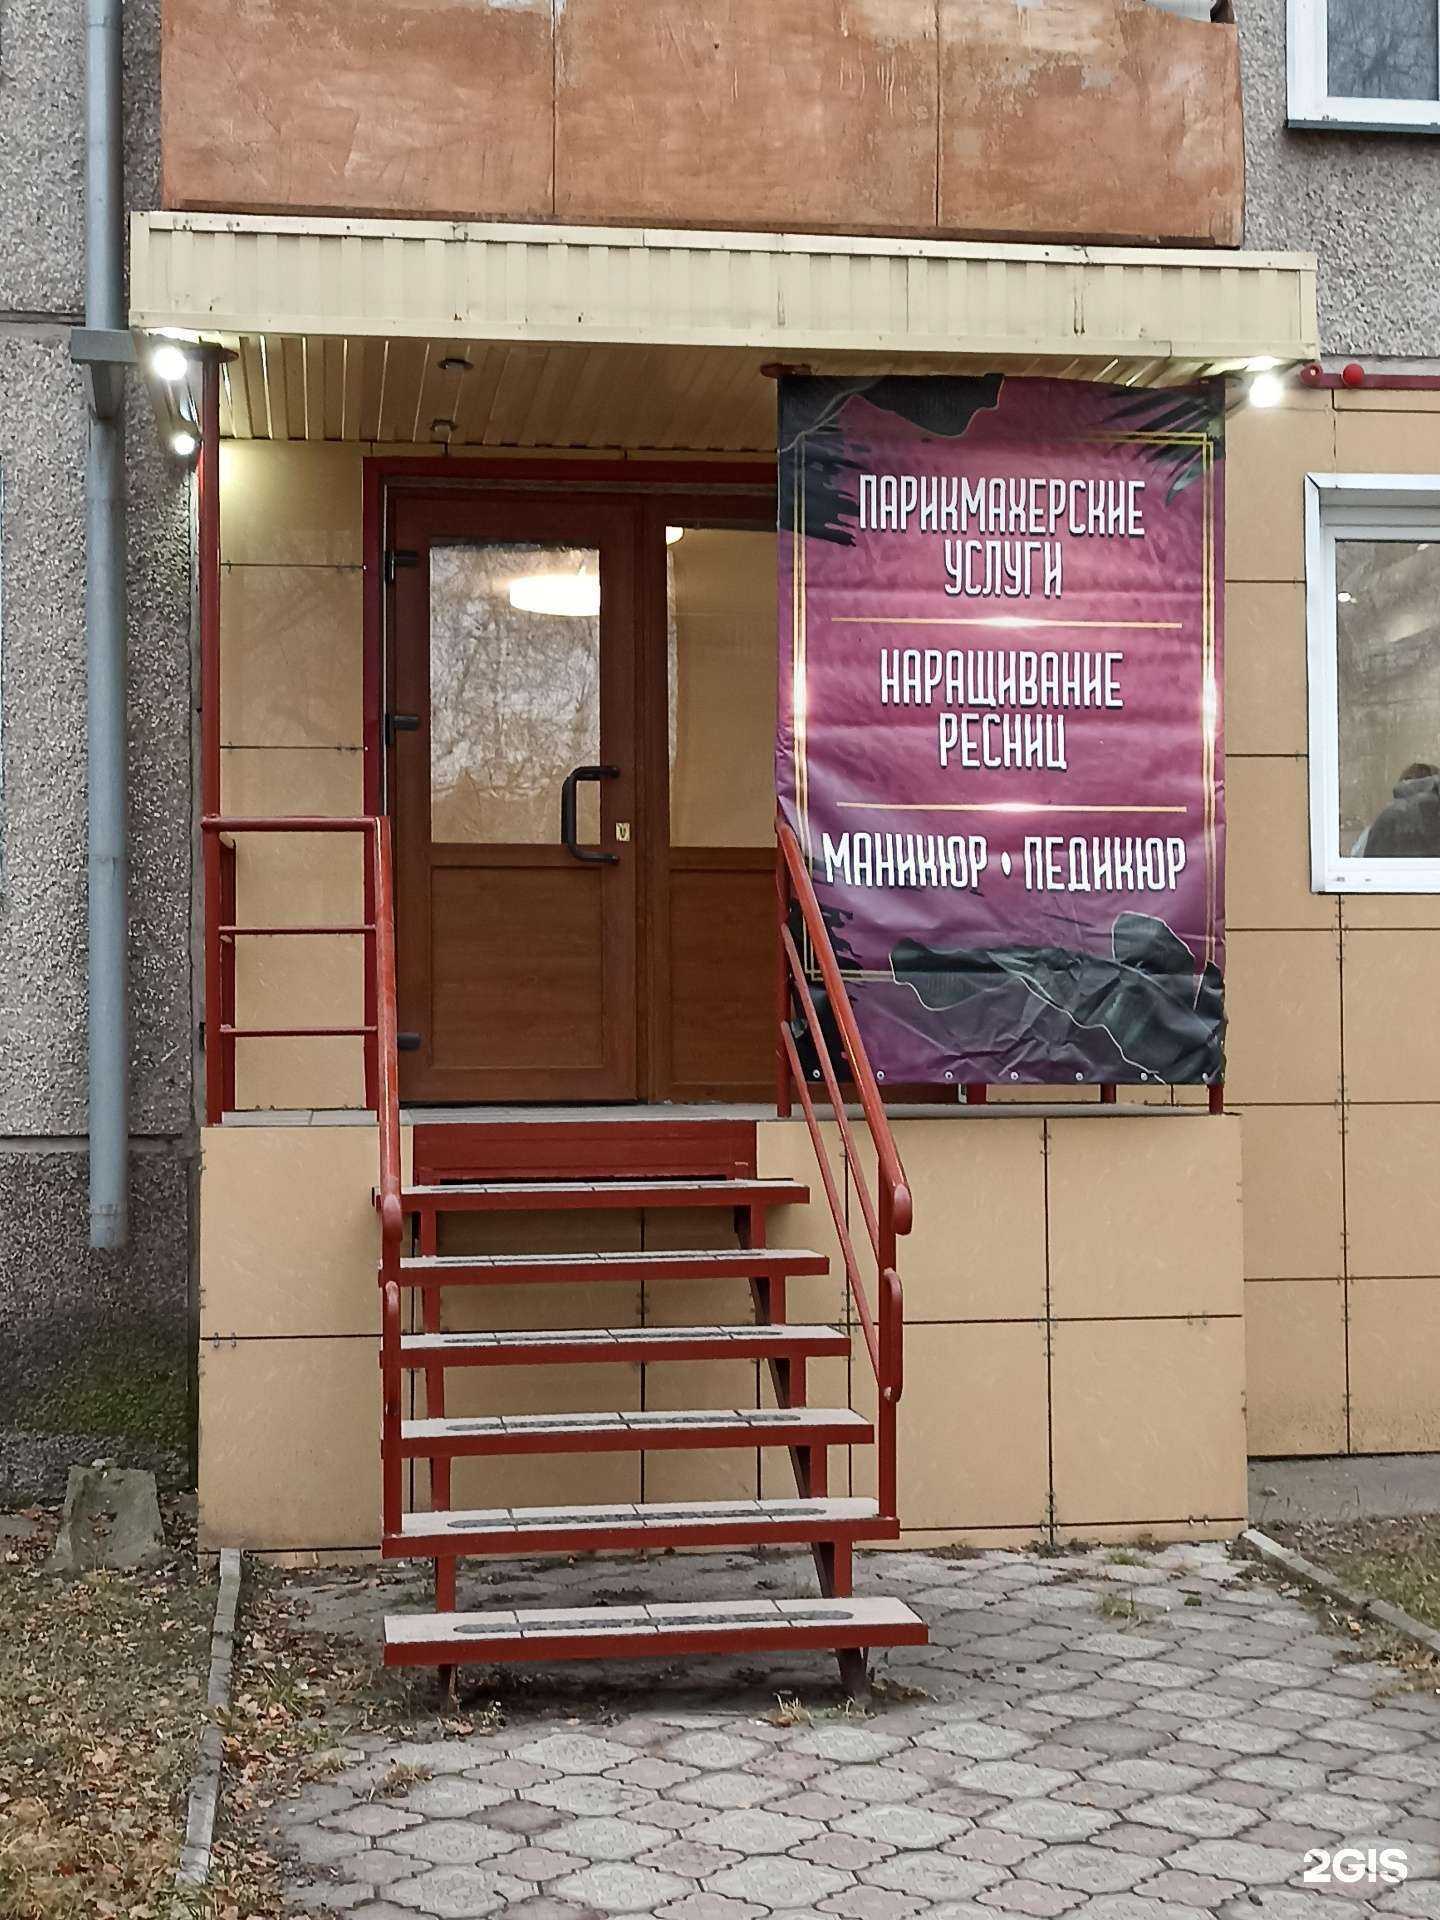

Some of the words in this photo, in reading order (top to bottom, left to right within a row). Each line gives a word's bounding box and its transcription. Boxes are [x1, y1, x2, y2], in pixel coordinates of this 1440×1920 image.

[859, 474, 1146, 536] ПАРИКМАХЕРСКИЕ
[944, 540, 1063, 597] УСЛУГИ
[880, 648, 1124, 708] НАРАЩИВАНИЕ
[938, 712, 1067, 770] РЕСНИЦ
[821, 831, 988, 888] МАНИКЮР
[1023, 837, 1186, 892] ПЕДИКЮР
